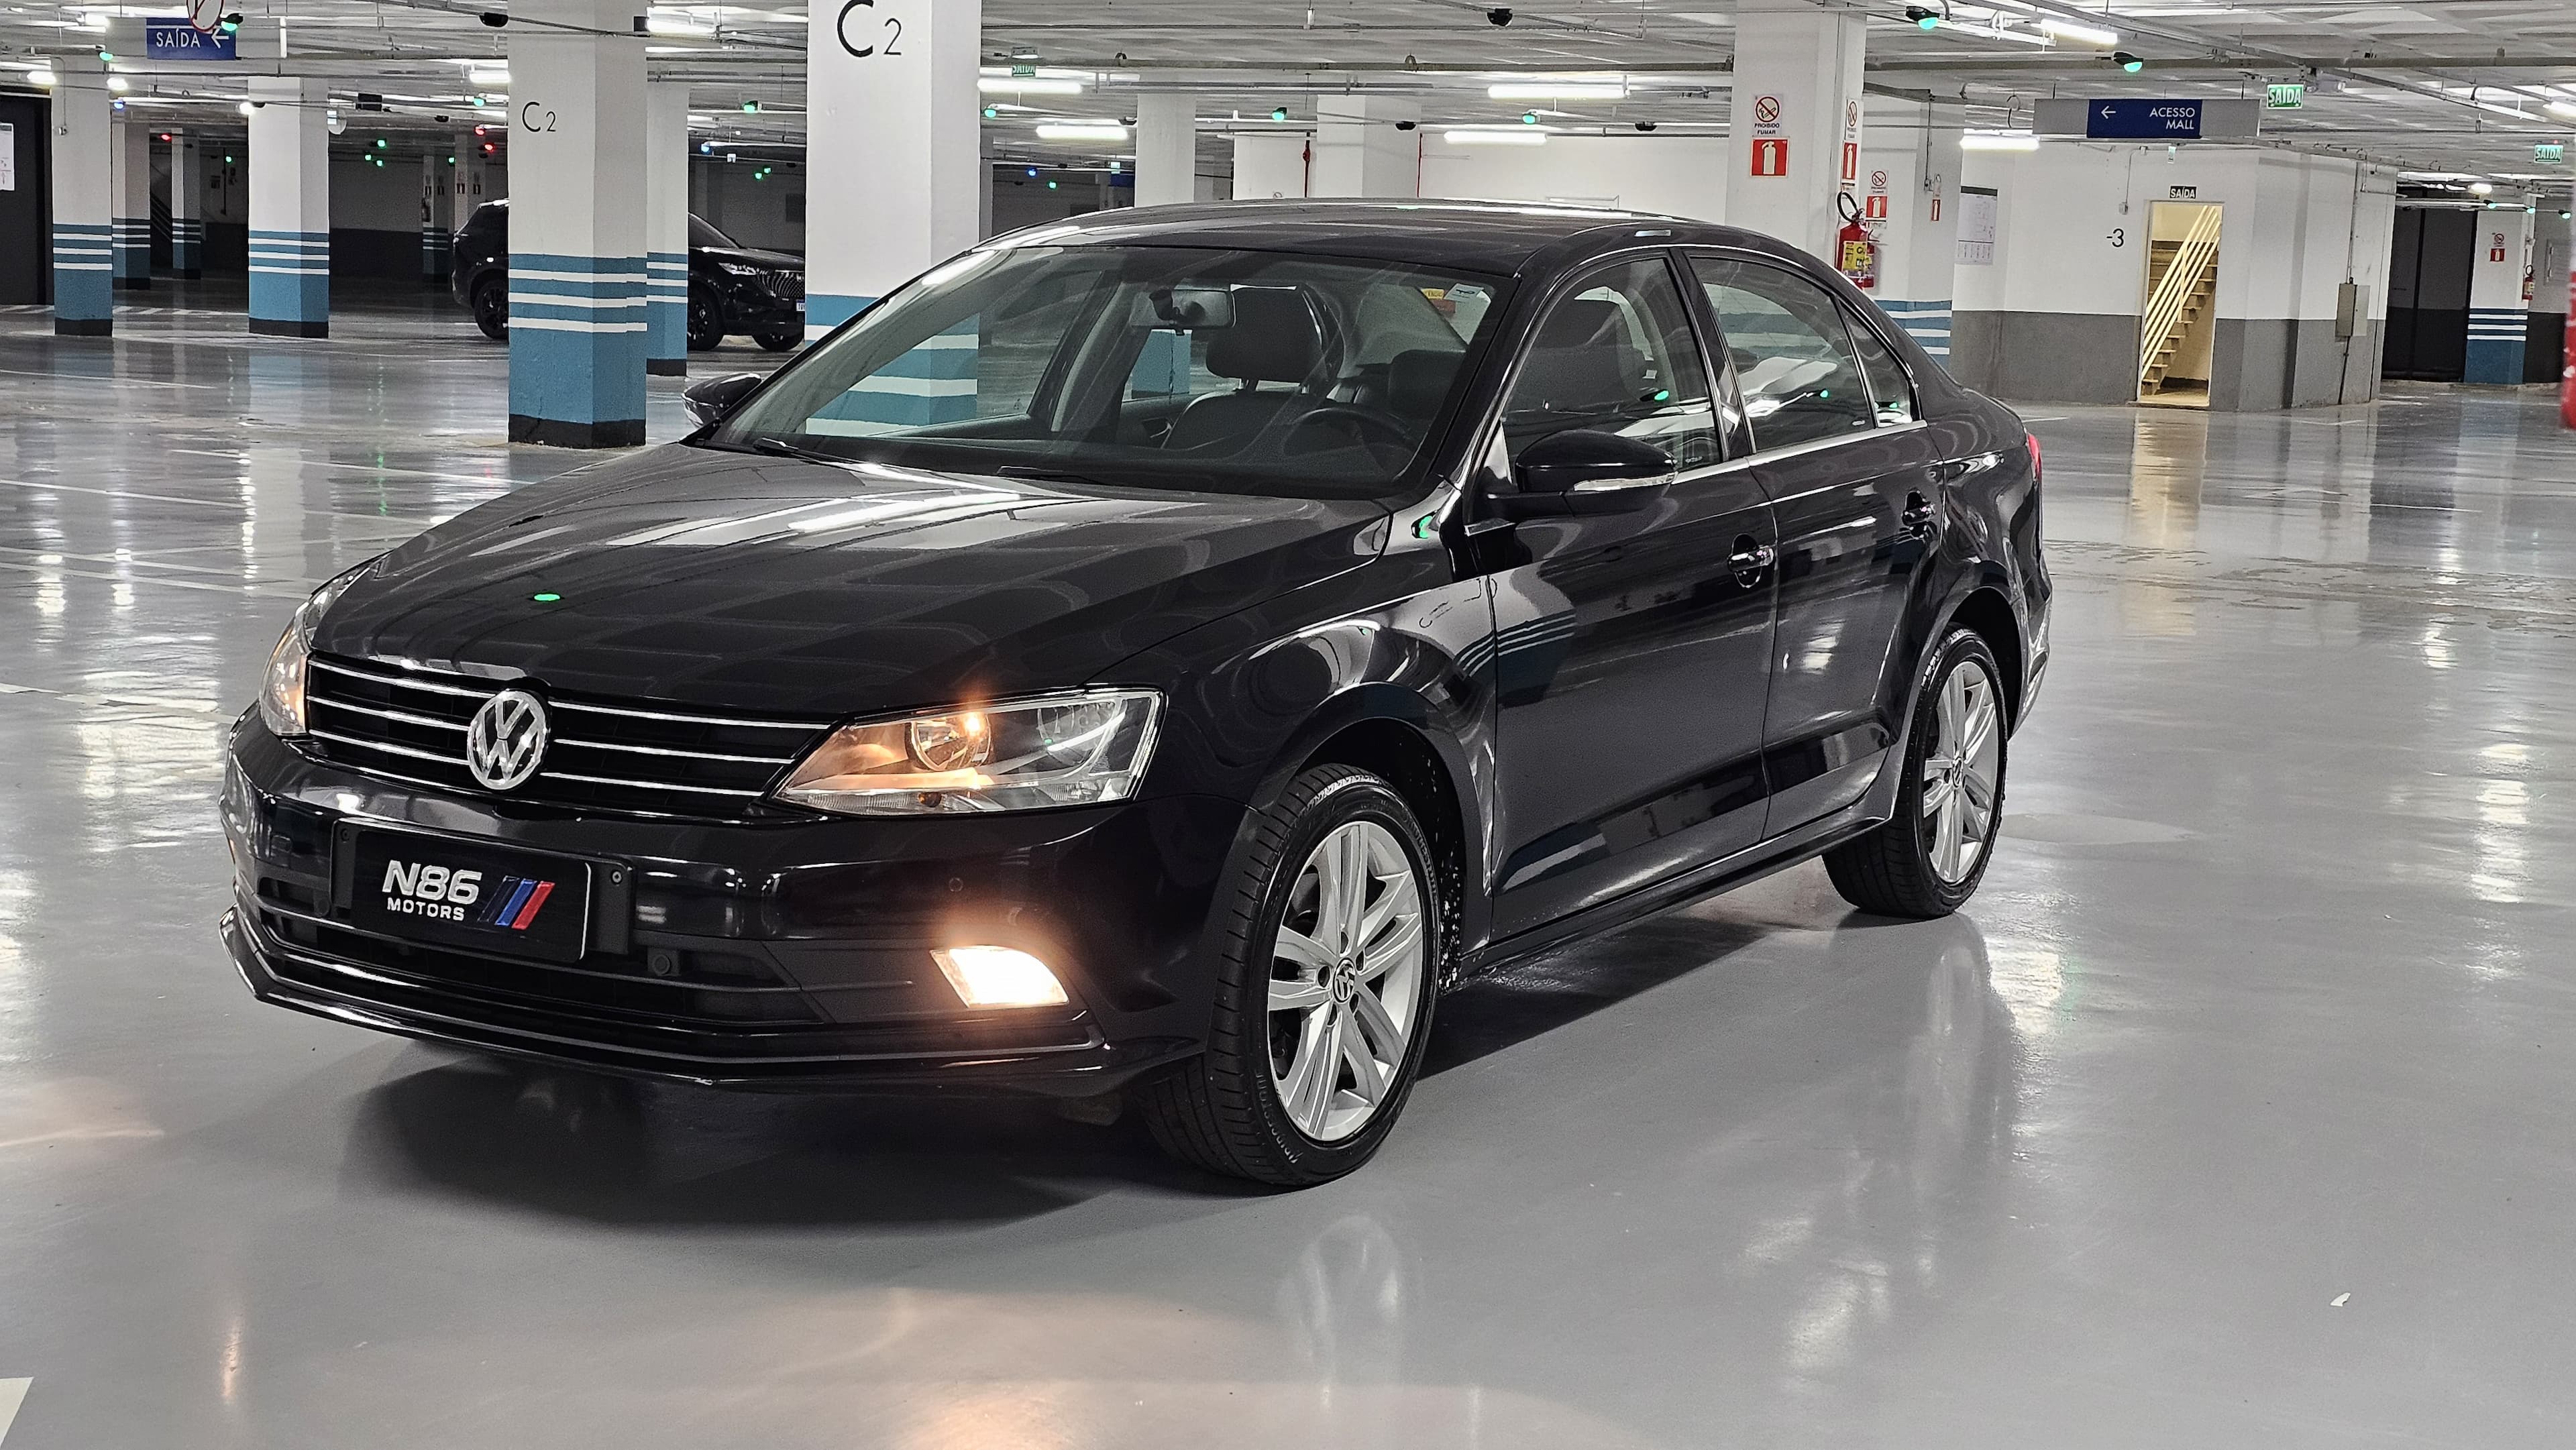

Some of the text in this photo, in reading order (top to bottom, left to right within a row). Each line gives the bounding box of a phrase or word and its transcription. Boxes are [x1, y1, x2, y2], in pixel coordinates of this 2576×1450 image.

[156, 27, 201, 48] SAÍDA
[2149, 107, 2196, 118] ACESSO
[2165, 119, 2194, 130] MALL
[2170, 187, 2196, 199] SAÍDA
[2106, 228, 2125, 247] -3
[382, 859, 483, 905] N86
[387, 897, 465, 922] MOTORS
